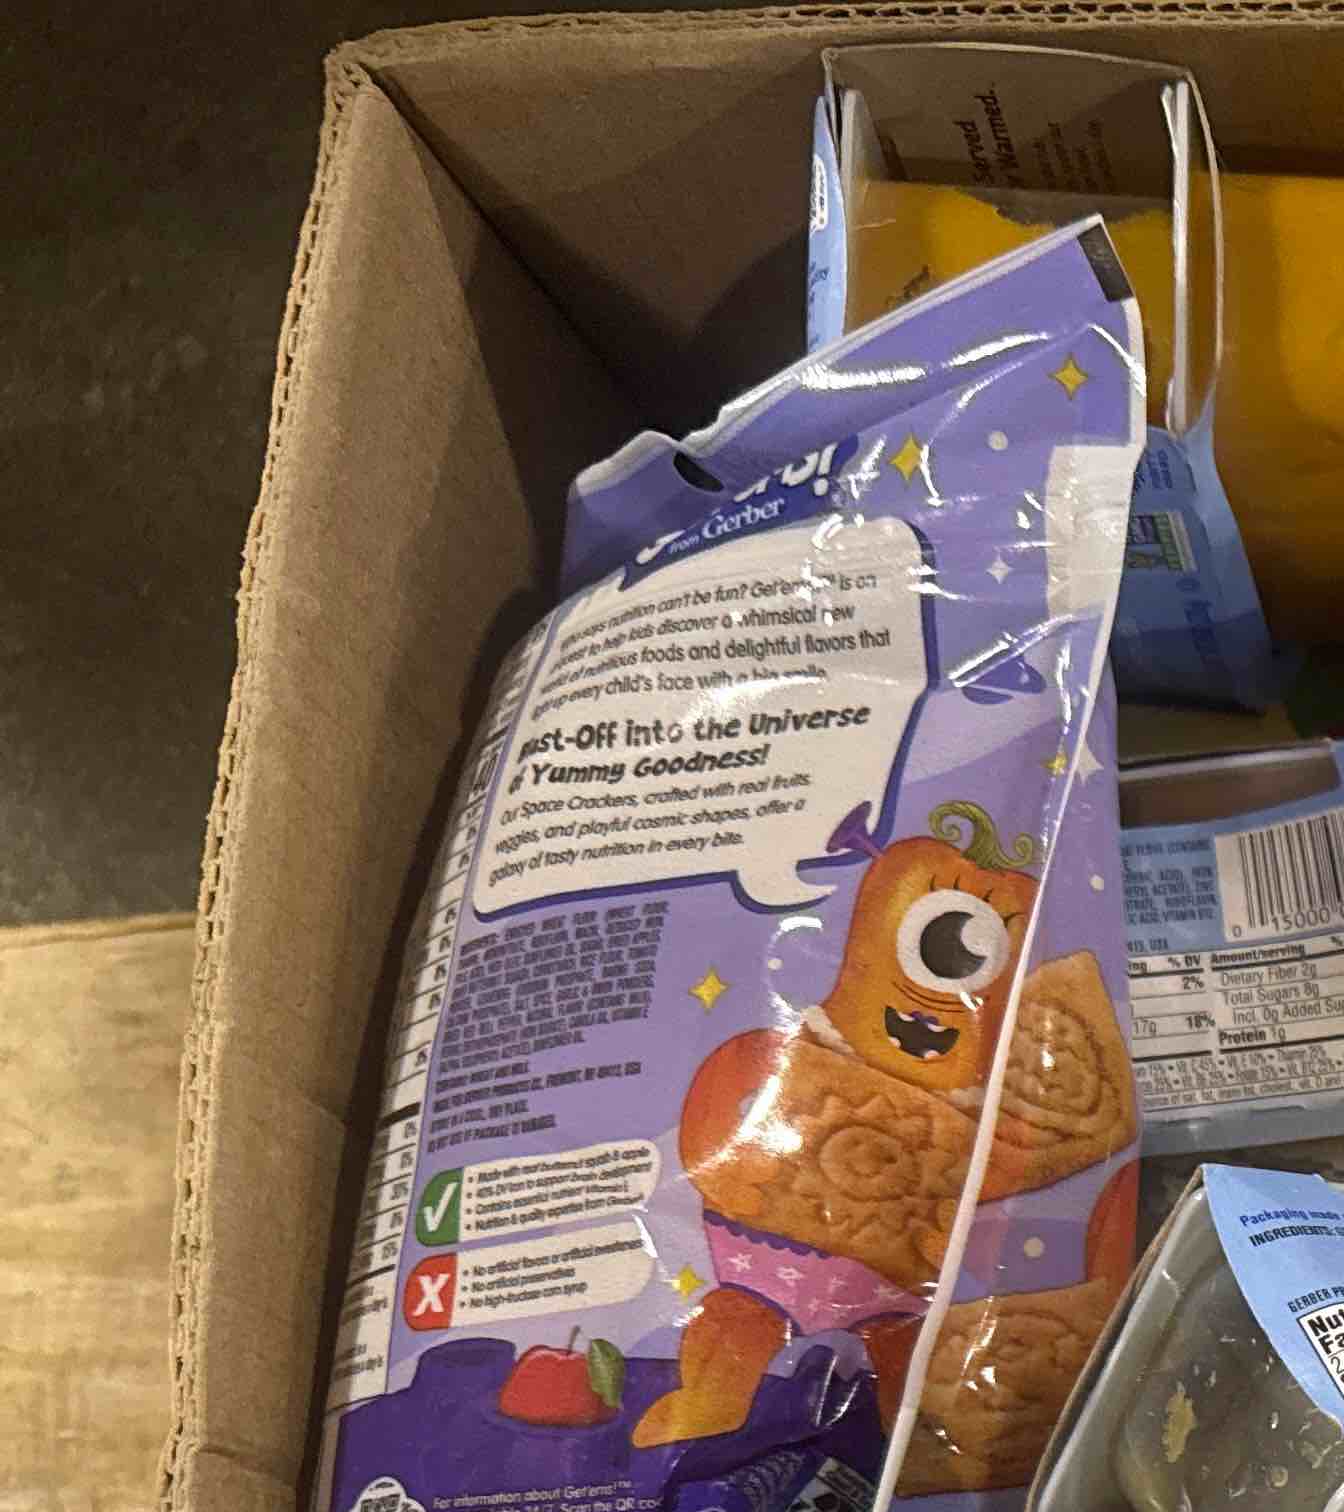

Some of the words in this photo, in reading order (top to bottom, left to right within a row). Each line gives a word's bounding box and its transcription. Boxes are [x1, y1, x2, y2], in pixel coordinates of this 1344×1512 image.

[702, 497, 785, 540] Gerber
[694, 715, 741, 742] the
[748, 704, 871, 736] Universe
[531, 759, 625, 787] Yummy
[633, 743, 772, 779] Goodness!
